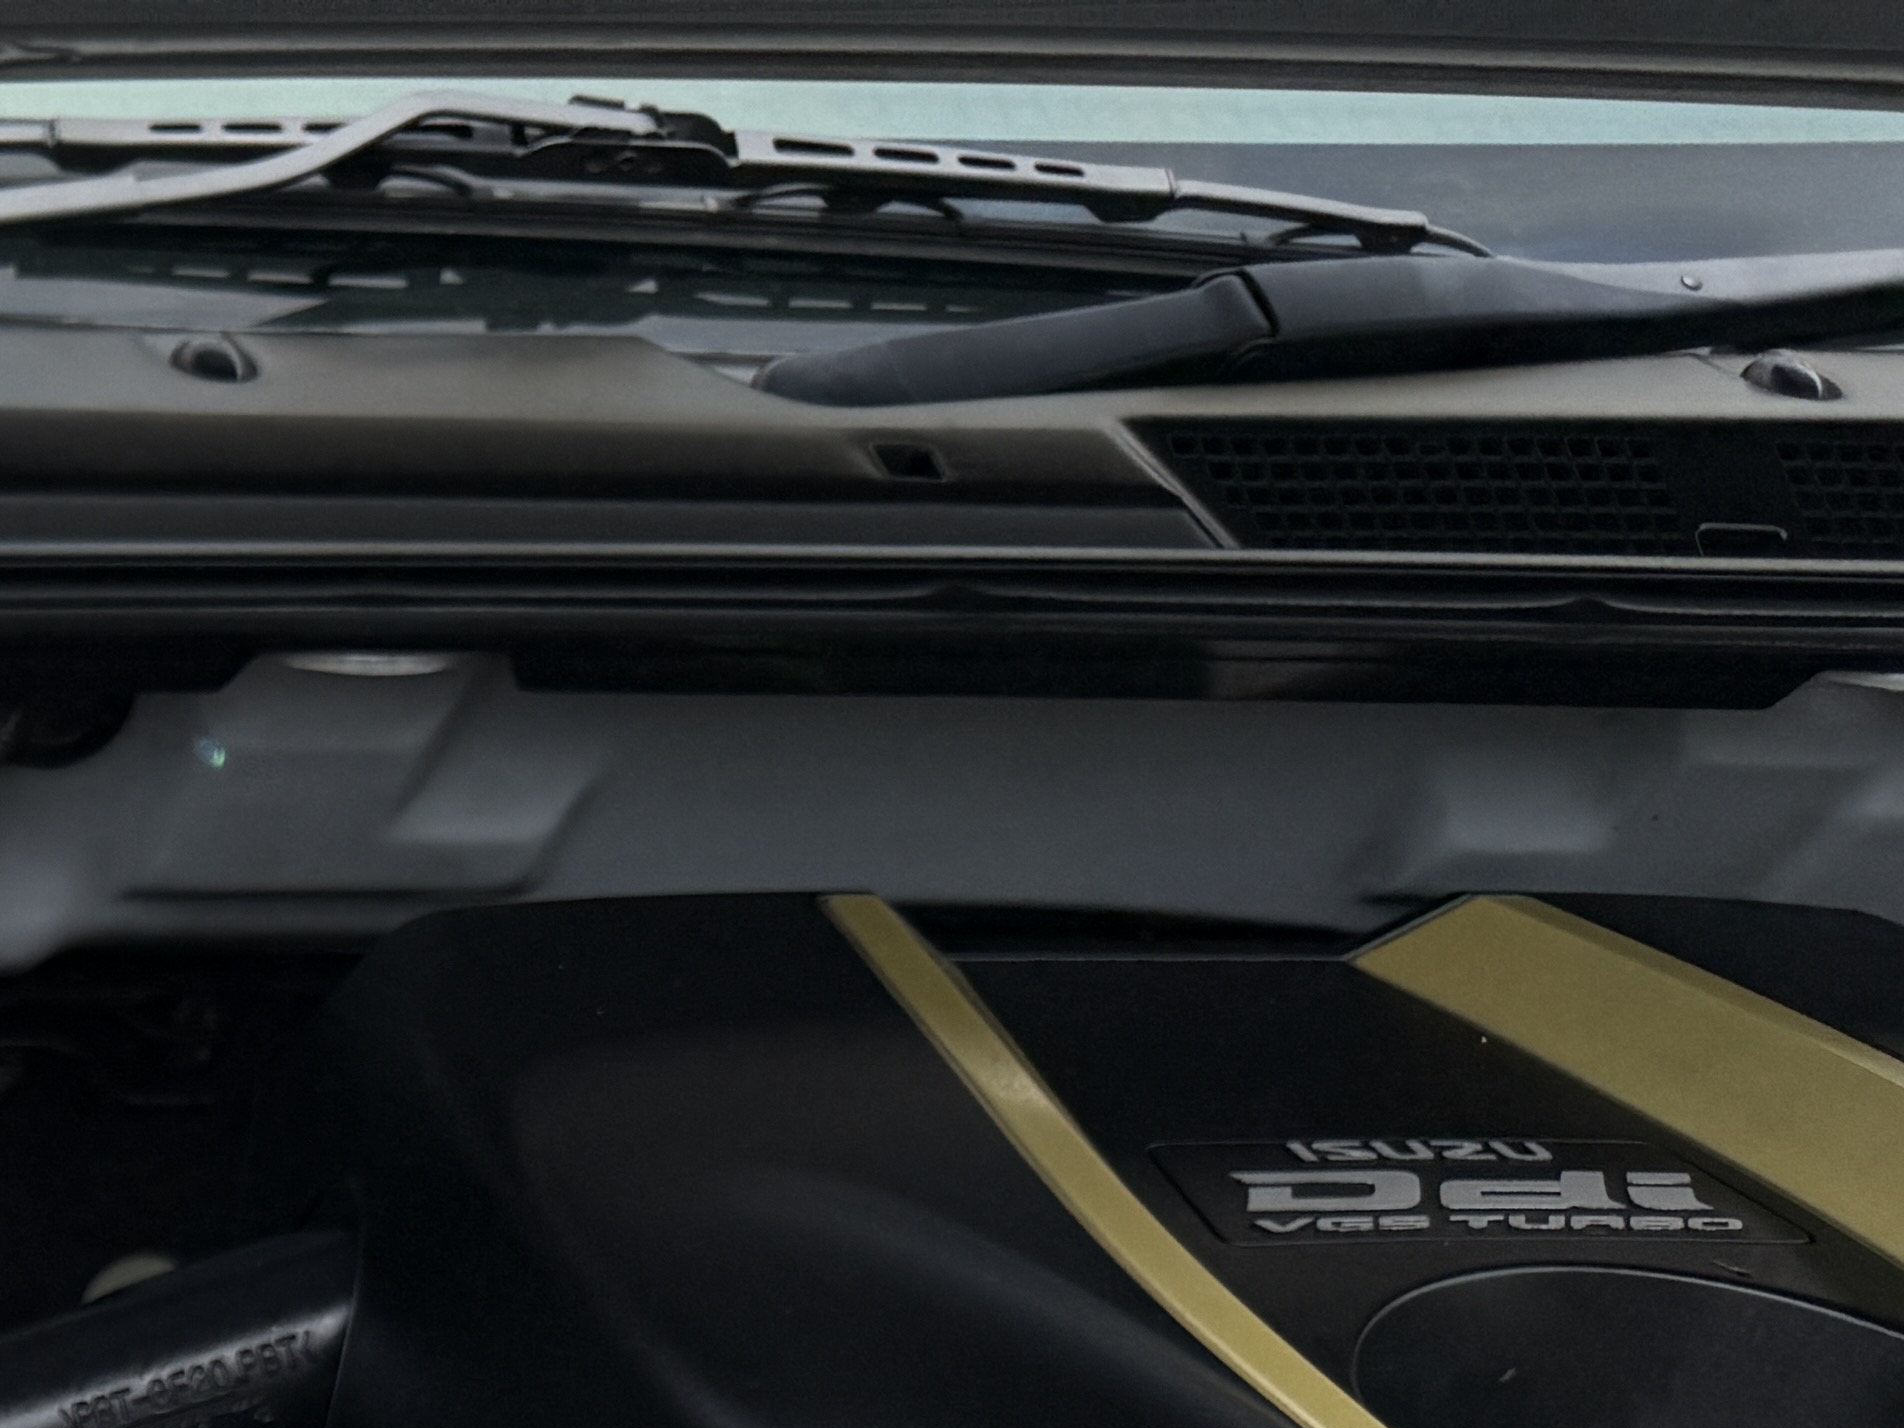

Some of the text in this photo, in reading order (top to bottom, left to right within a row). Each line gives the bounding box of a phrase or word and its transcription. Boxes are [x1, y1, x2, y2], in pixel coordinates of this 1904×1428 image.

[1285, 1139, 1553, 1162] ISUZU
[1253, 1214, 1743, 1233] VGS TURBO
